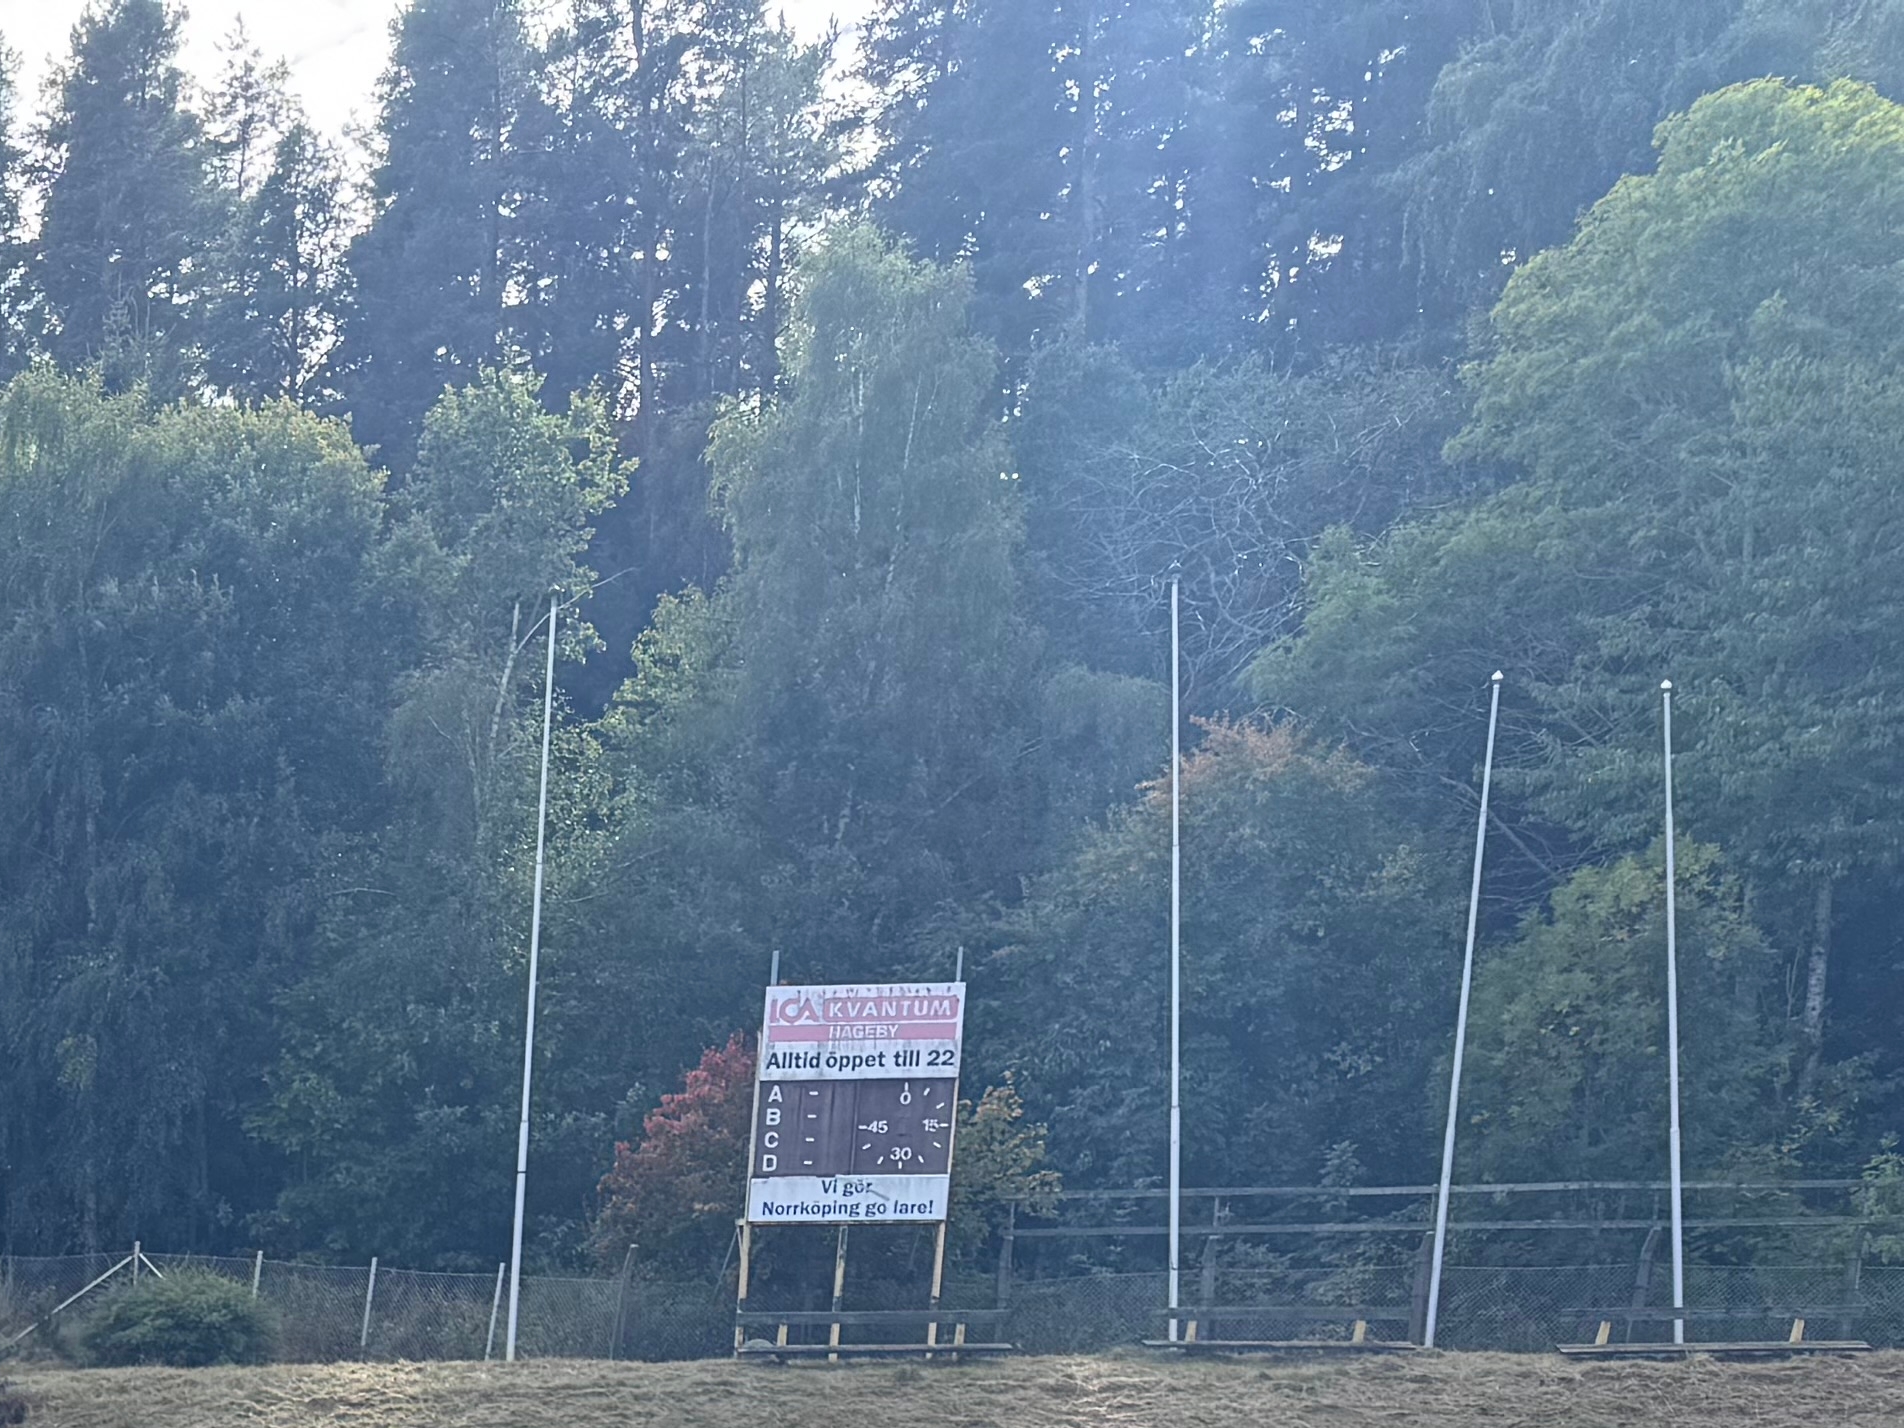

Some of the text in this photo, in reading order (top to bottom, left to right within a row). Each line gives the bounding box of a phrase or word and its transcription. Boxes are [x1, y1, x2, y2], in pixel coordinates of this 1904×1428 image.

[769, 997, 951, 1023] ICA KVANTUM
[828, 1023, 899, 1039] HAGEBY
[766, 1049, 955, 1072] Alltid öppet till 22
[768, 1084, 783, 1103] A
[765, 1108, 781, 1126] B
[922, 1118, 939, 1132] 15
[867, 1120, 889, 1134] 45
[764, 1131, 779, 1148] C
[890, 1147, 912, 1161] 30
[762, 1154, 777, 1172] D
[821, 1179, 874, 1197] Vi gör
[762, 1200, 862, 1217] Norrköping
